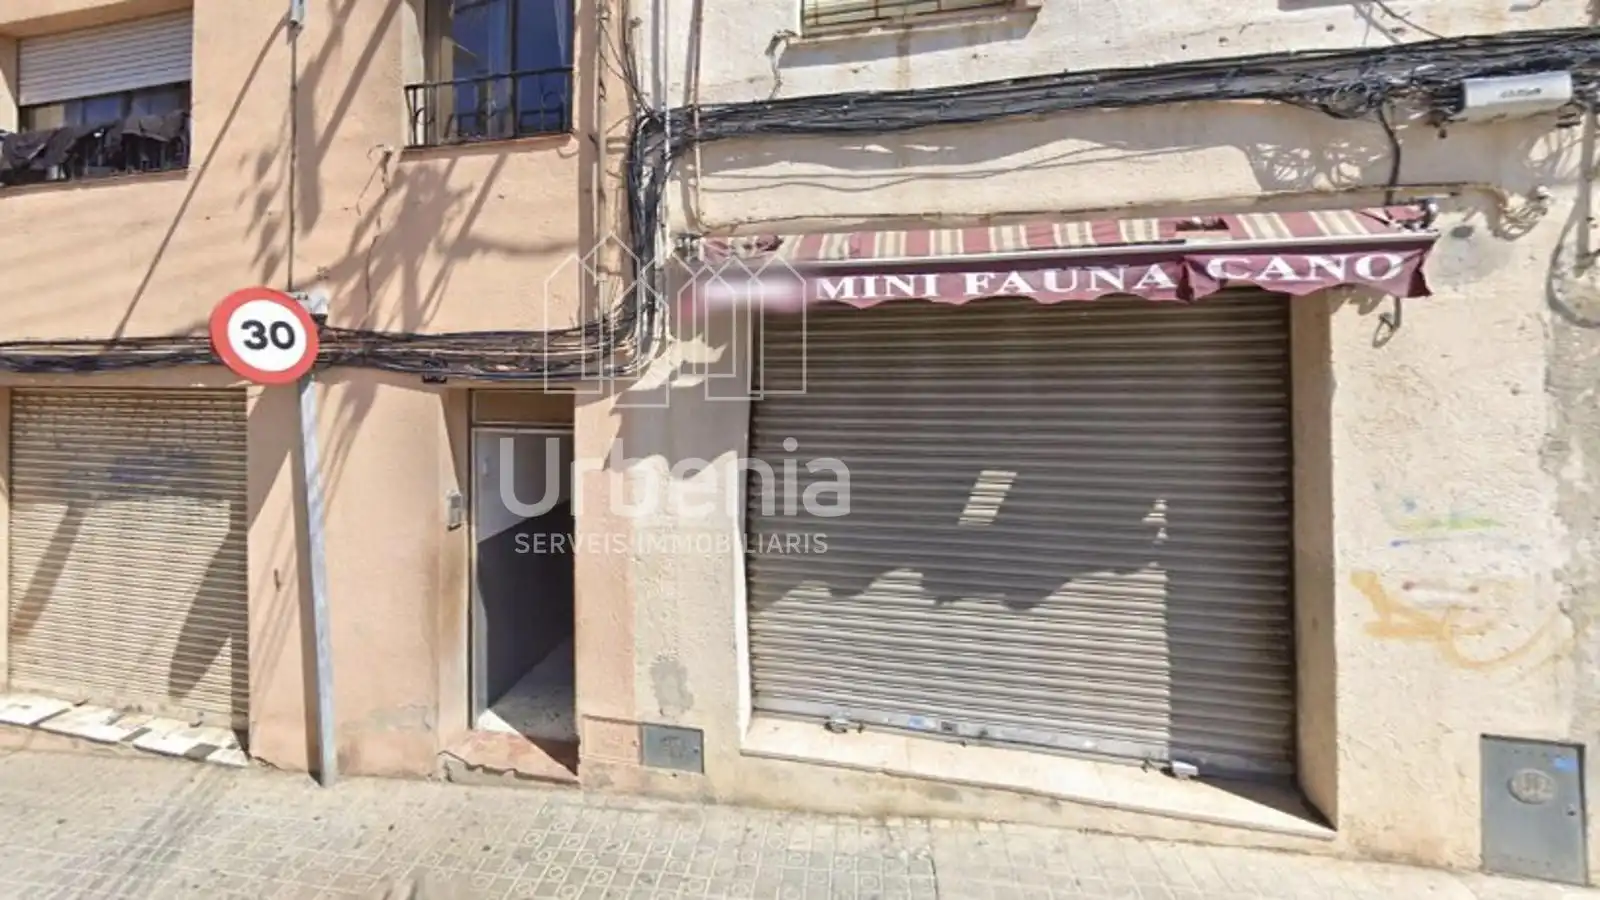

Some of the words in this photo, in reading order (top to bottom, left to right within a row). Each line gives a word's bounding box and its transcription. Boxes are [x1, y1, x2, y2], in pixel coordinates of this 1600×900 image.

[815, 273, 940, 299] MINI
[963, 263, 1178, 298] FAUNA
[1206, 253, 1402, 282] CANO
[241, 319, 296, 350] 30
